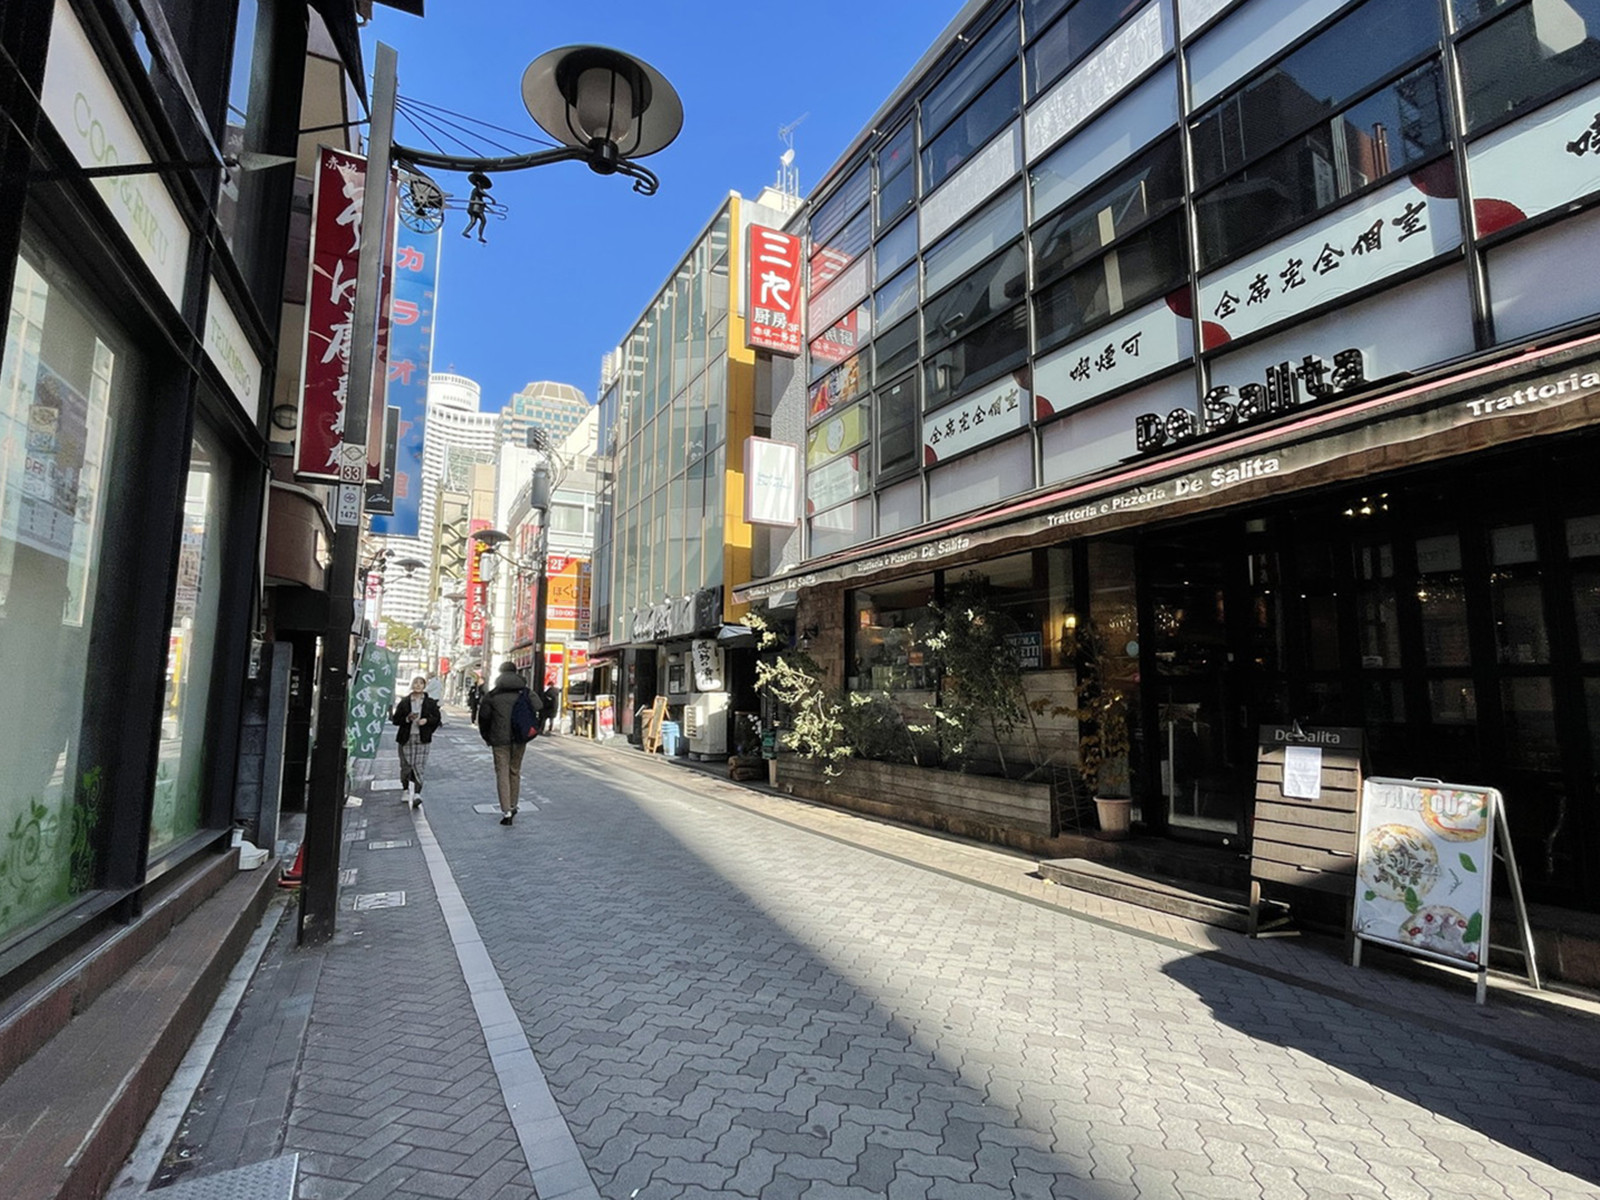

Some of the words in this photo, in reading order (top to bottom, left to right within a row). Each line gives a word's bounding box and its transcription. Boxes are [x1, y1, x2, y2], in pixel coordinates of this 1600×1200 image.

[1214, 201, 1427, 320] 全席完全個室
[1070, 331, 1142, 382] 喫煙可
[1135, 407, 1193, 453] De
[1204, 349, 1366, 431] Salita
[1466, 372, 1600, 416] Trattoria
[344, 466, 360, 480] 33
[1047, 506, 1096, 527] Trattoria
[1100, 503, 1109, 514] e
[1112, 488, 1166, 511] Pizzeria
[1175, 478, 1203, 497] De
[1210, 457, 1280, 487] Salita
[1381, 787, 1425, 812] TAKE
[1430, 793, 1472, 817] OUT
